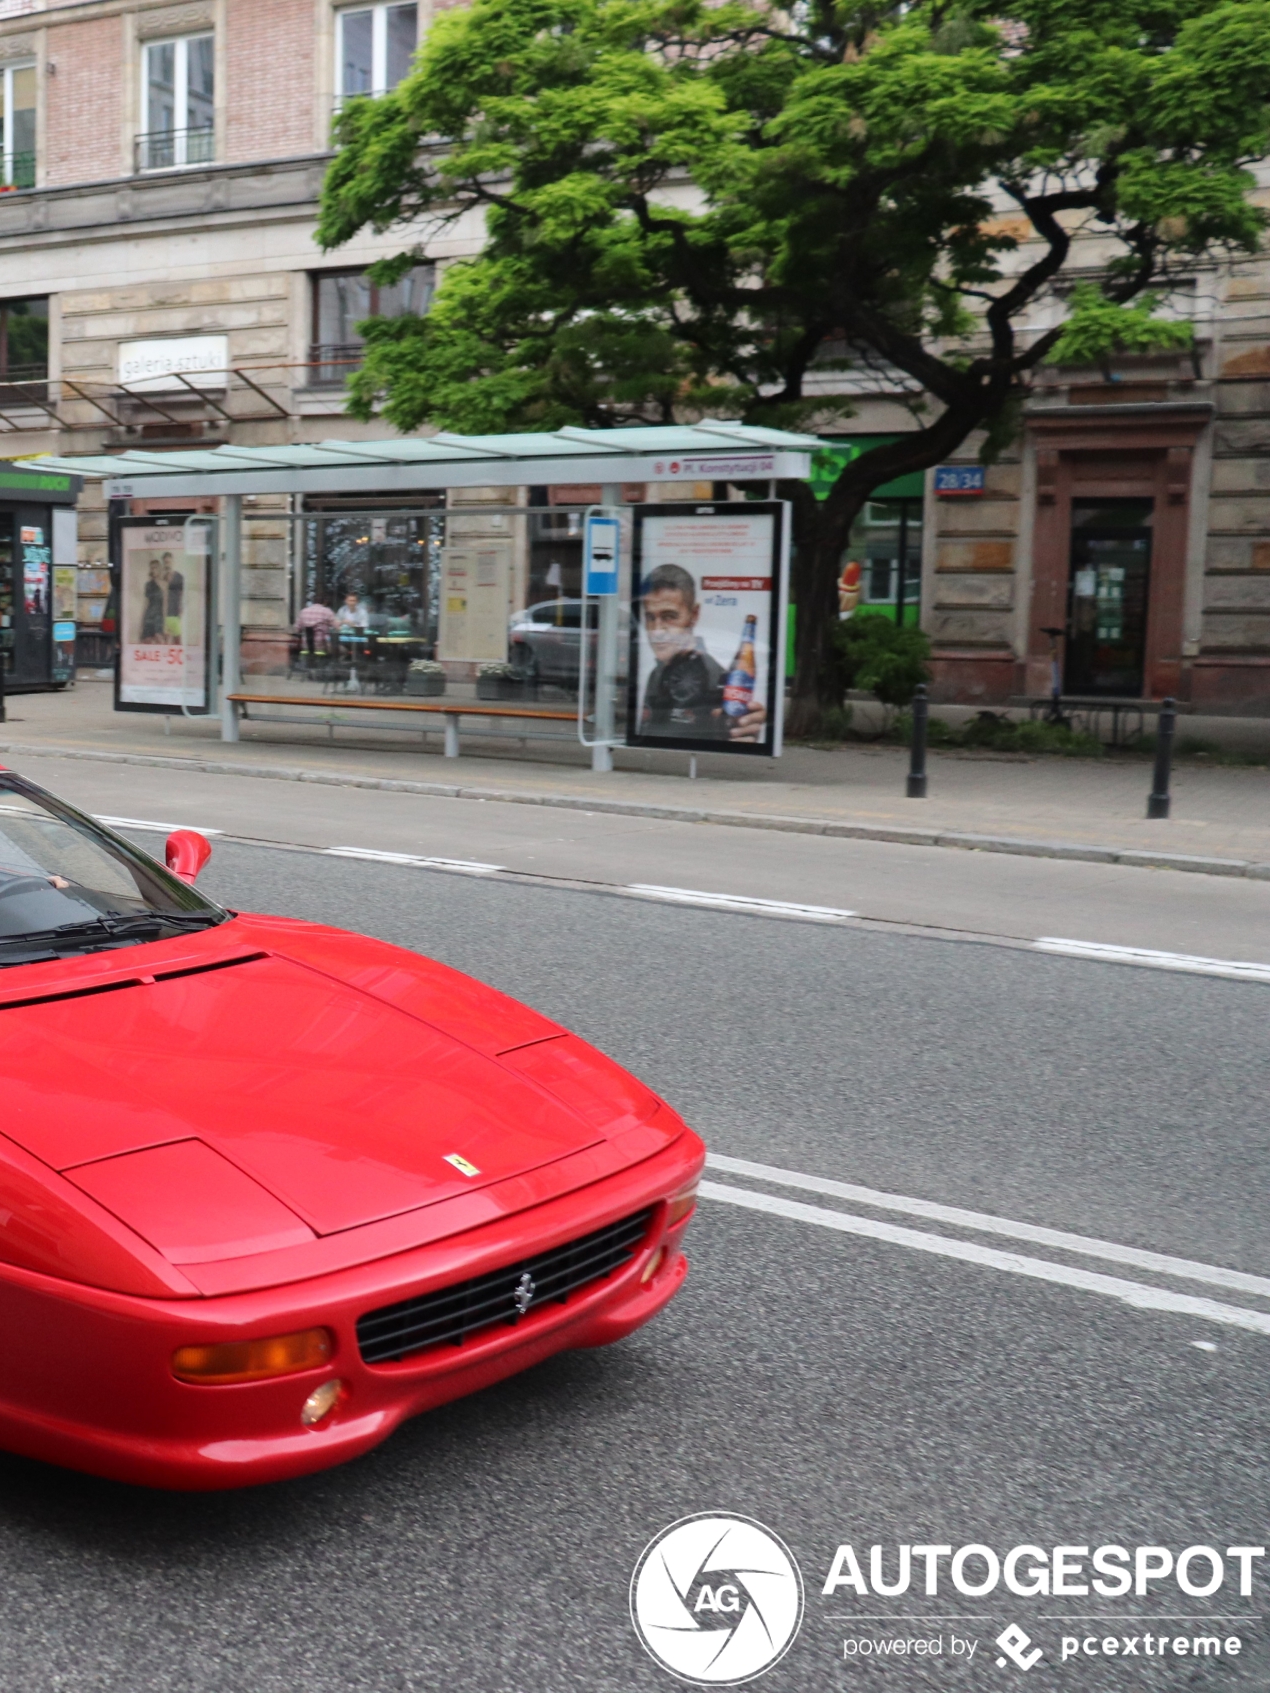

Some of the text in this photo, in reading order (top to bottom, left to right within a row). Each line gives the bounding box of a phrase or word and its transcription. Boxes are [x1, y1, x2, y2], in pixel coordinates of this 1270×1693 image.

[123, 350, 222, 379] galeria sztuki
[133, 650, 161, 662] SALE
